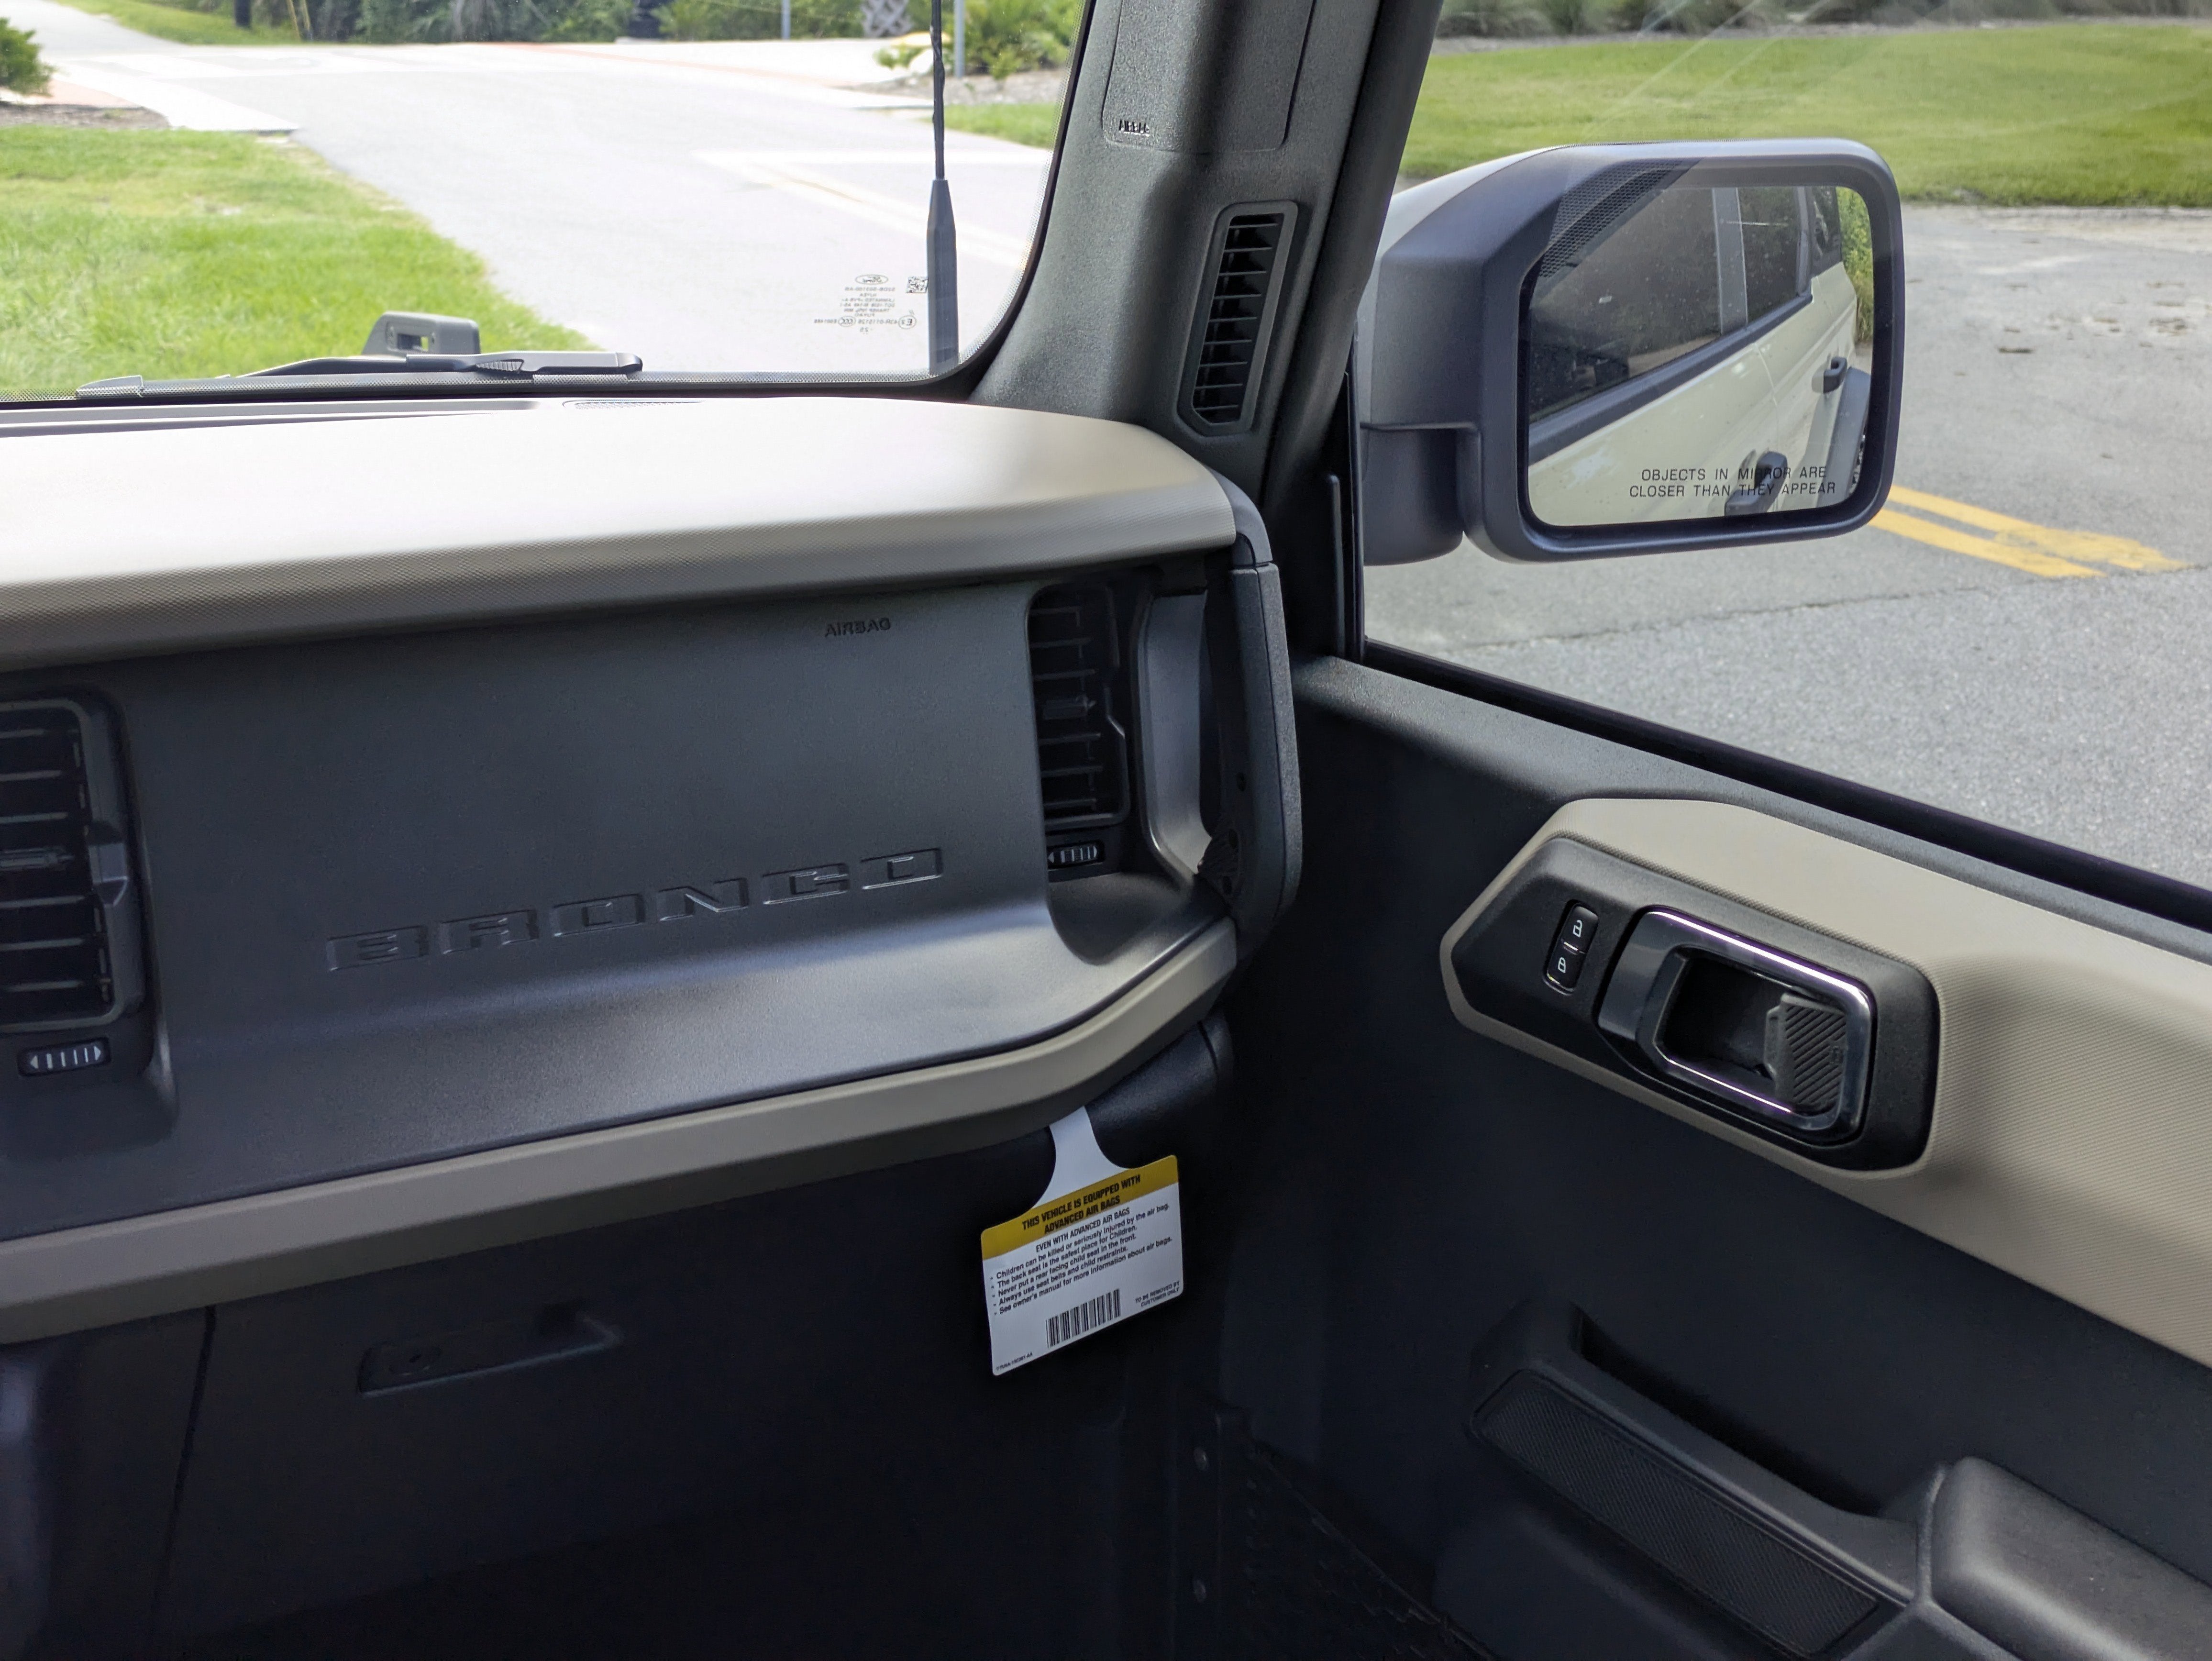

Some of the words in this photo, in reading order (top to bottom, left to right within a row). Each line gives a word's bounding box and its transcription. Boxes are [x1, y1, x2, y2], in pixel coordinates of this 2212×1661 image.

[1629, 485, 1685, 498] CLOSER
[1694, 485, 1731, 497] THAN
[1739, 483, 1775, 496] THEY
[1781, 481, 1836, 494] APPEAR
[1641, 468, 1706, 482] OBJECTS
[1715, 468, 1728, 480] IN
[1799, 465, 1827, 478] ARE
[825, 618, 891, 638] AIRBAG
[326, 847, 944, 972] BRONCO
[1022, 1216, 1040, 1230] THIS
[1041, 1202, 1073, 1222] VEHICLE
[1074, 1198, 1082, 1208] IS
[1083, 1183, 1119, 1205] EQUIPPED
[1121, 1174, 1141, 1189] WITH
[1036, 1240, 1051, 1252] EVEN
[1053, 1232, 1069, 1244] WITH
[1070, 1219, 1101, 1238] ADVANCED
[1103, 1214, 1112, 1224] AIR
[1114, 1207, 1130, 1219] BAGS
[1044, 1210, 1084, 1234] ADVANCED
[1086, 1204, 1099, 1217] AIR
[1101, 1196, 1120, 1210] BAGS
[996, 1263, 1024, 1279] Children
[1025, 1258, 1037, 1267] can
[1048, 1245, 1064, 1257] killed
[1074, 1229, 1102, 1245] seriously
[1104, 1220, 1125, 1233] injured
[1127, 1216, 1134, 1225] by
[1136, 1212, 1146, 1220] the
[1147, 1207, 1155, 1216] air
[1156, 1203, 1170, 1212] bag.
[997, 1279, 1010, 1288] The
[1011, 1271, 1027, 1282] back
[1028, 1264, 1040, 1275] seat
[1050, 1256, 1060, 1265] the
[1061, 1248, 1080, 1261] safest
[1081, 1240, 1098, 1254] place
[1099, 1236, 1108, 1244] for
[1109, 1225, 1138, 1240] Children.
[998, 1285, 1017, 1297] Never
[1018, 1279, 1029, 1289] put
[1036, 1271, 1048, 1280] rear
[1050, 1261, 1069, 1274] facing
[1070, 1253, 1085, 1265] child
[1087, 1248, 1100, 1259] seat
[1108, 1240, 1119, 1250] the
[1120, 1233, 1137, 1244] front.
[999, 1291, 1022, 1306] Always
[1023, 1285, 1035, 1295] use
[1036, 1278, 1050, 1289] seat
[1051, 1272, 1066, 1283] belts
[1067, 1265, 1079, 1275] and
[1080, 1258, 1095, 1268] child
[1097, 1246, 1128, 1263] restraints.
[1000, 1305, 1012, 1314] See
[1013, 1293, 1038, 1308] owner's
[1039, 1282, 1062, 1297] manual
[1063, 1277, 1073, 1286] for
[1073, 1270, 1089, 1282] more
[1091, 1254, 1126, 1274] information
[1128, 1246, 1145, 1259] about
[1146, 1242, 1155, 1251] air
[1156, 1236, 1172, 1248] bags.
